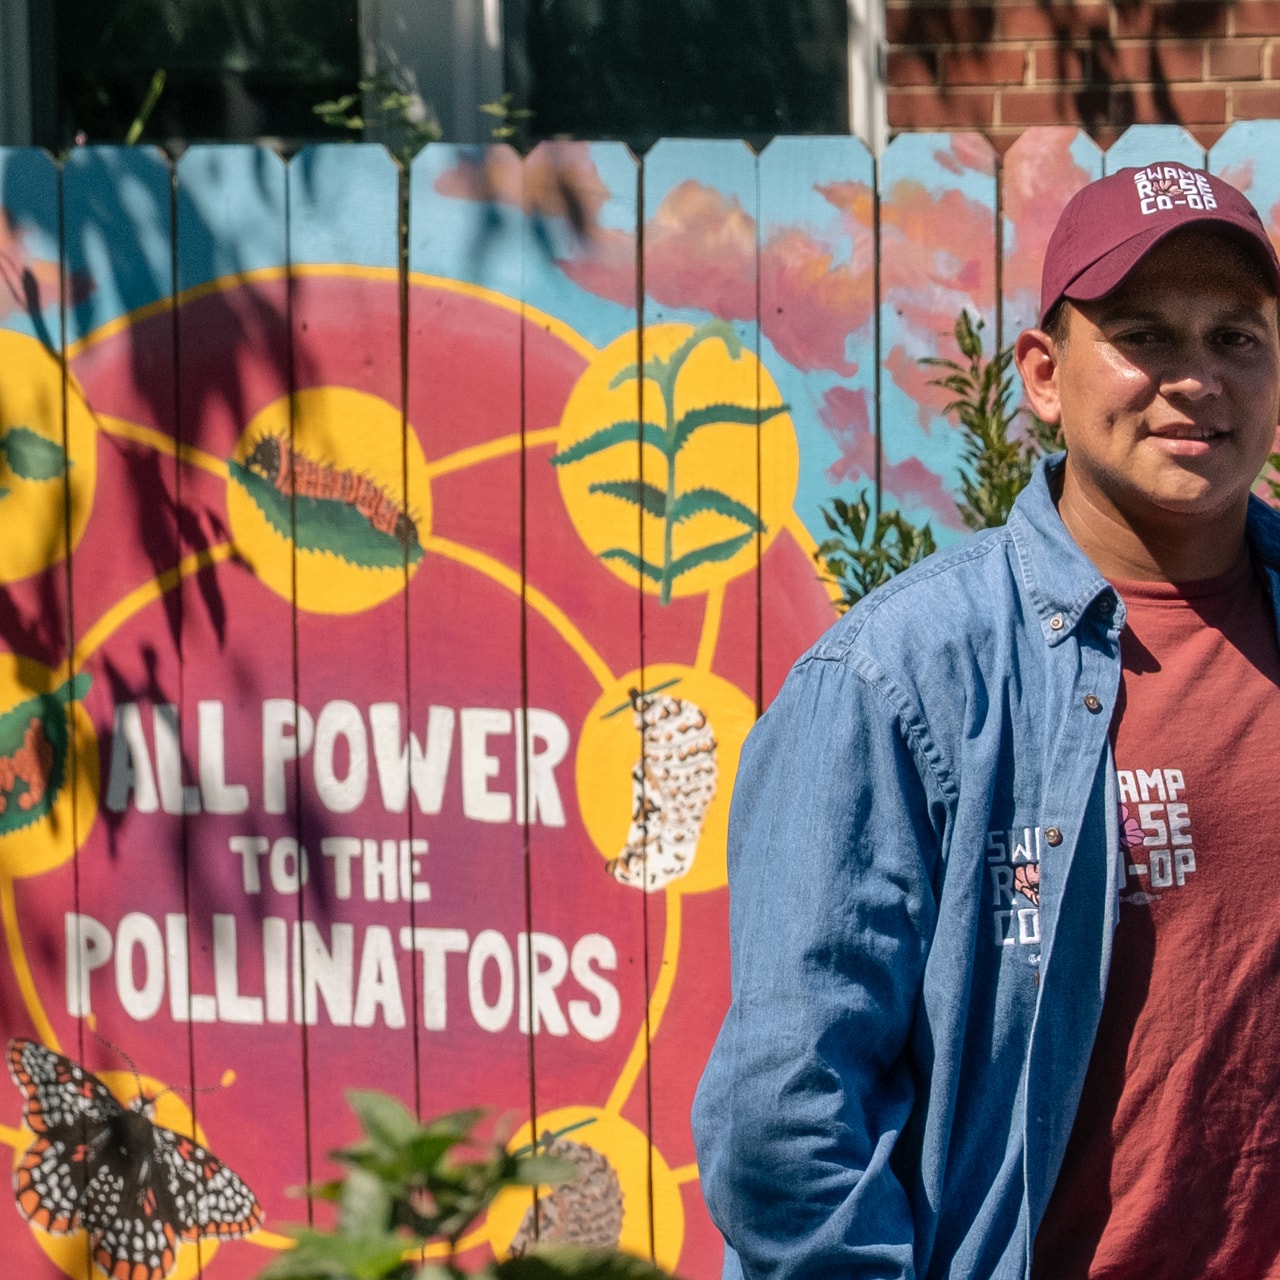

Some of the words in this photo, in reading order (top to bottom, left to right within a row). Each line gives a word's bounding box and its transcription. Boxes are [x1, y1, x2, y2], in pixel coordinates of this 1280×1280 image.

[1134, 166, 1208, 184] SWAMP
[1136, 178, 1214, 198] RSE
[1140, 195, 1218, 215] CO-OP
[107, 700, 250, 815] ALL
[261, 698, 570, 828] POWER
[1117, 768, 1185, 803] AMP
[229, 836, 309, 895] TO
[320, 837, 432, 903] THE
[64, 911, 622, 1042] POLLINATORS
